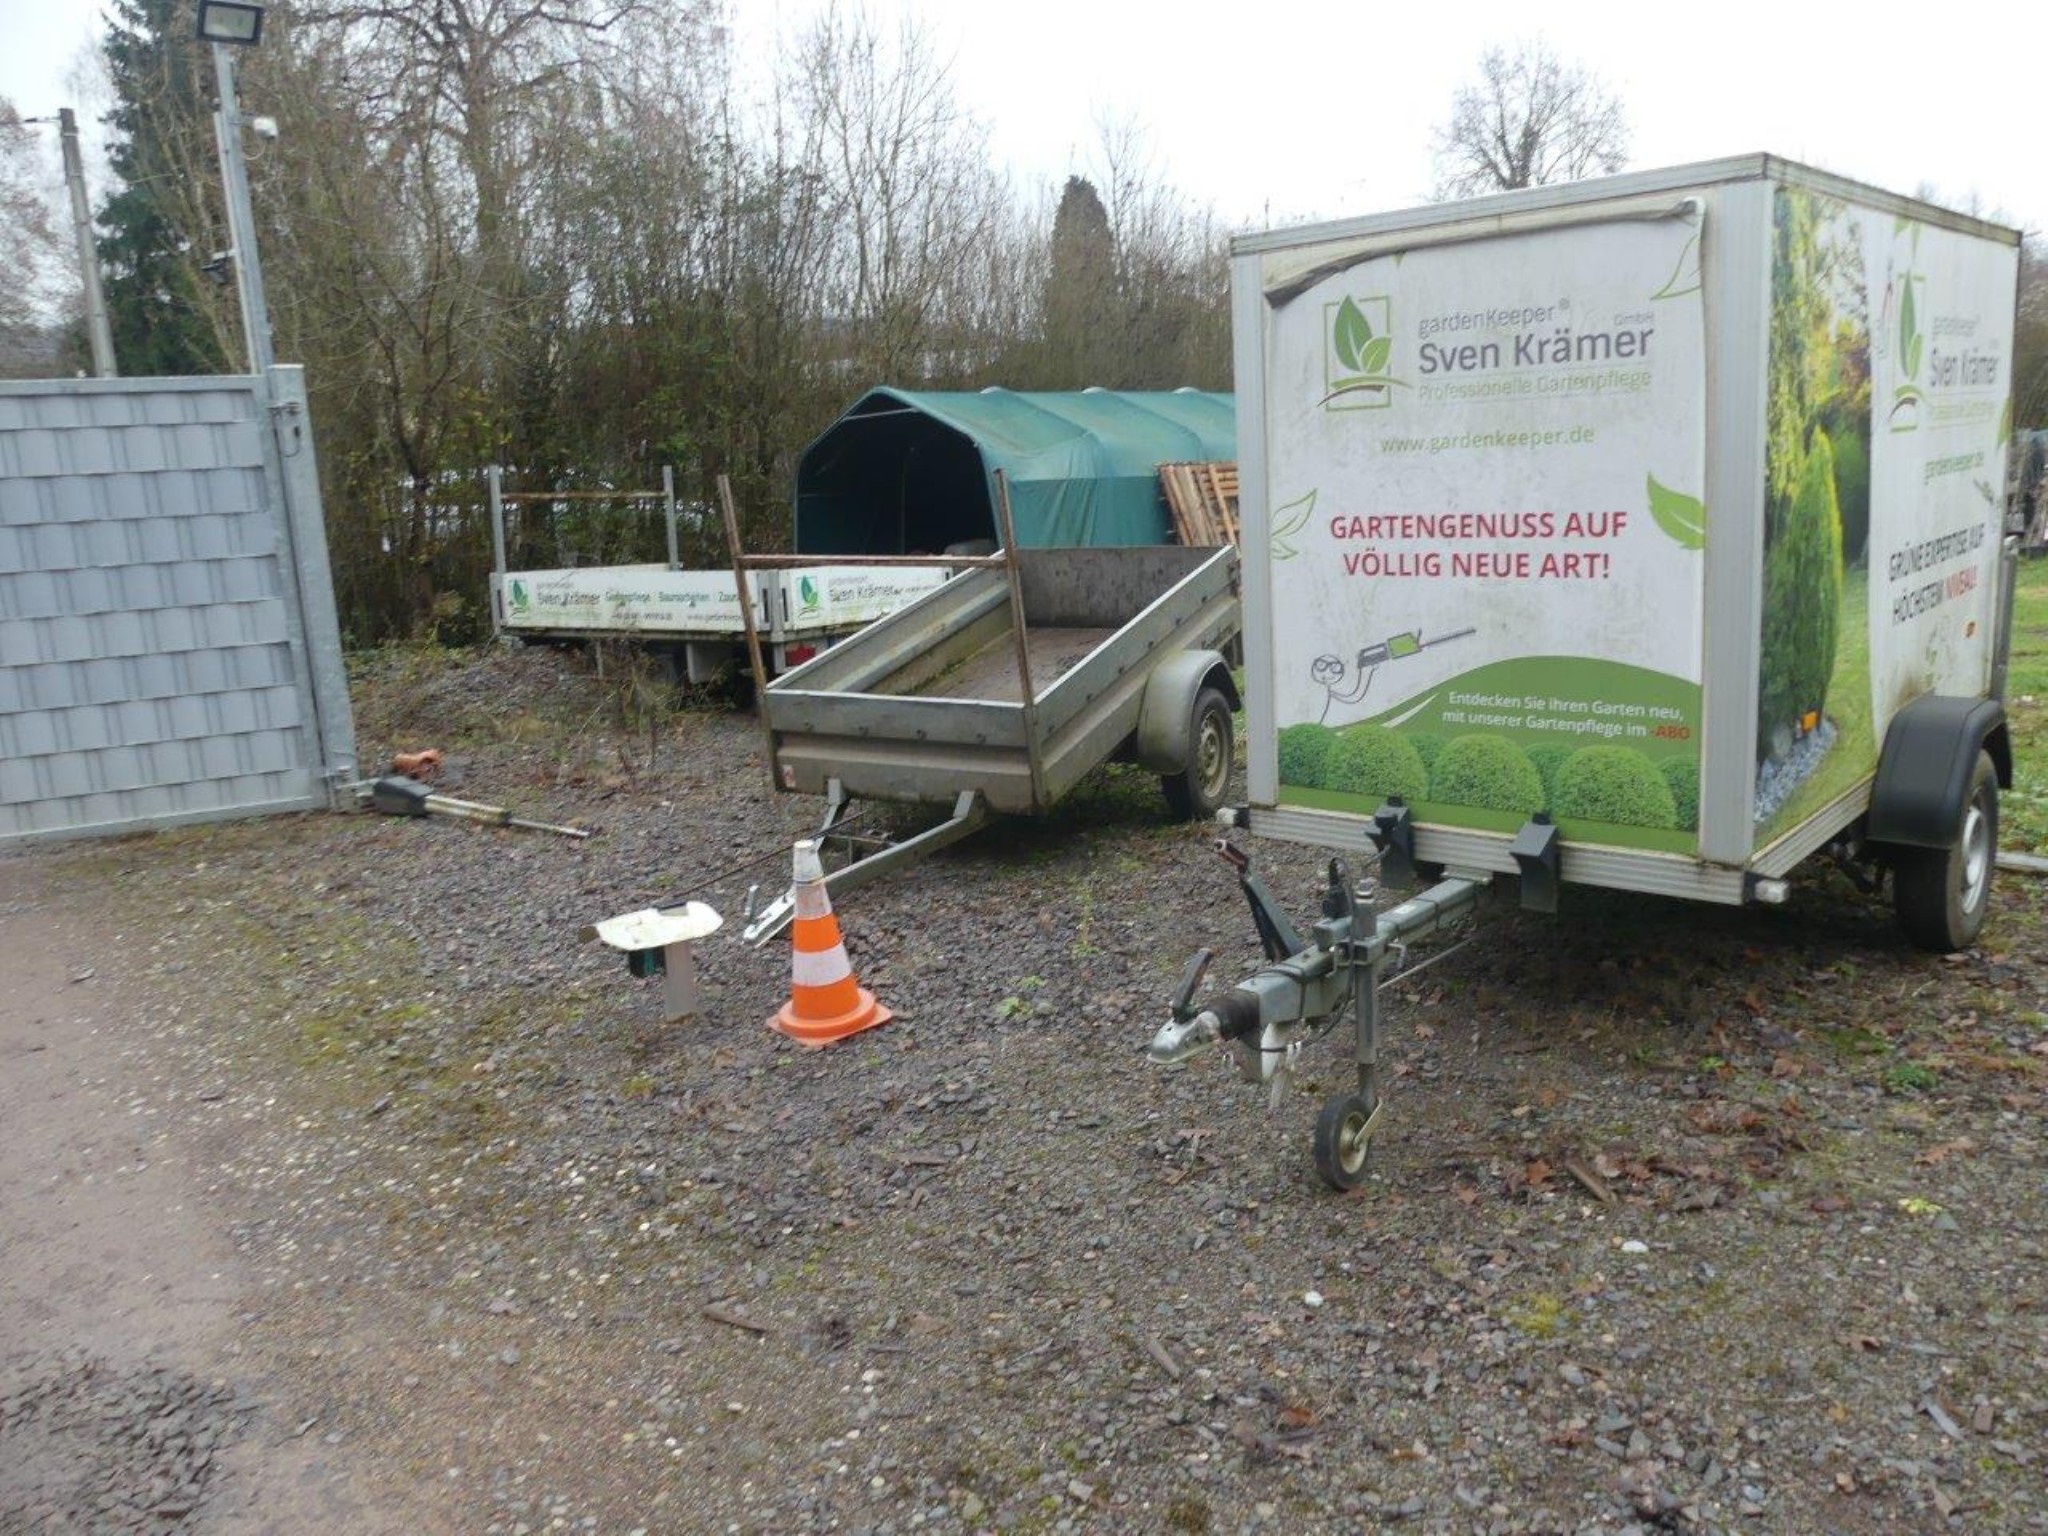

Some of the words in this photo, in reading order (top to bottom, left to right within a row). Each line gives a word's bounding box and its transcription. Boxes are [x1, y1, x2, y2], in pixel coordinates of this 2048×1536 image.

[1419, 342, 1499, 374] Sven
[1514, 327, 1654, 367] Krämer
[1930, 348, 1958, 387] Sven
[1418, 379, 1533, 401] Professionelle
[1536, 370, 1652, 395] Gartenpflege
[1380, 427, 1595, 455] www.gardenkeeper.de
[1330, 513, 1555, 540] GARTENGENUSS
[1563, 511, 1628, 538] AUF
[1343, 546, 1441, 577] VÖLLIG
[1451, 552, 1530, 578] NEUE
[1539, 552, 1610, 579] ART!
[1449, 691, 1521, 709] Entdecken
[1524, 696, 1546, 711] Sie
[1592, 700, 1645, 717] Garten
[1649, 706, 1685, 722] neu,
[1442, 709, 1465, 724] mit
[1468, 713, 1522, 728] unserer
[1526, 715, 1623, 738] Gartenpflege
[1626, 723, 1648, 737] im
